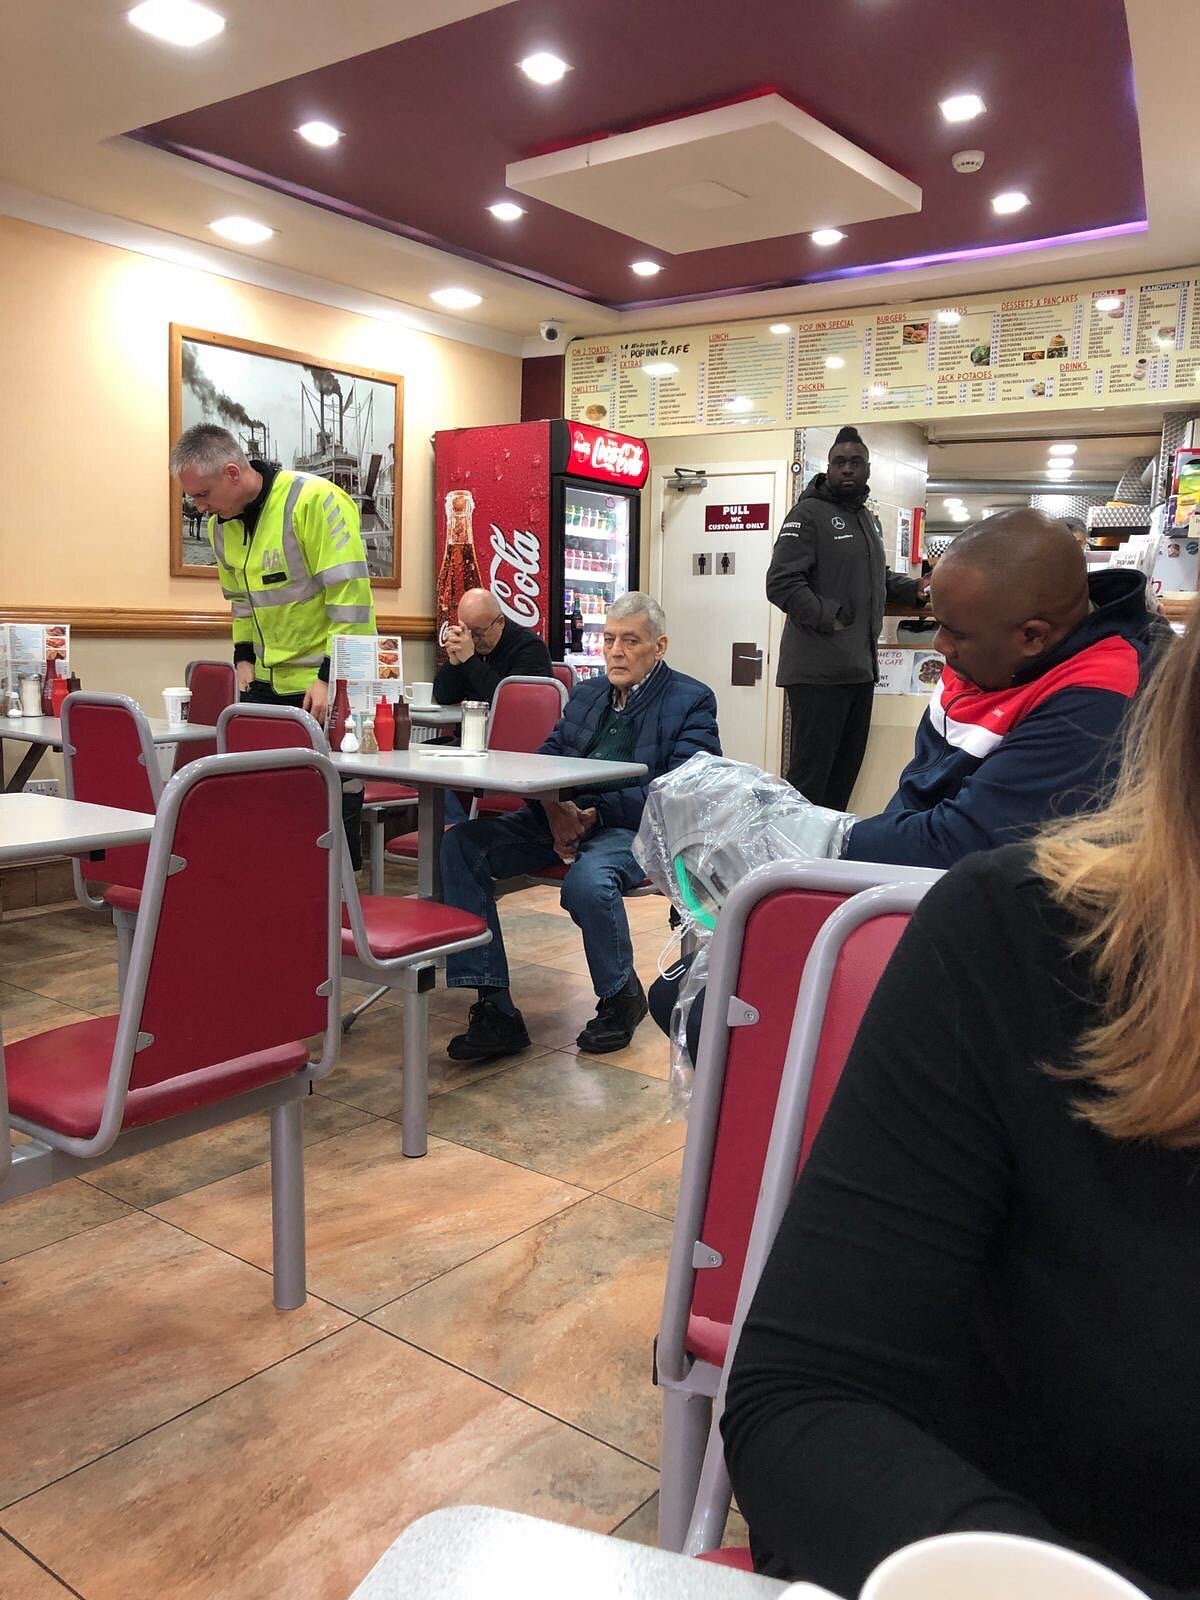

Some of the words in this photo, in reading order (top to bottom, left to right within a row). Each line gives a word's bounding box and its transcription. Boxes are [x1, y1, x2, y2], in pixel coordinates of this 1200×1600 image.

[1001, 299, 1034, 311] DESSERTS
[1043, 294, 1078, 305] PANCAKES
[876, 313, 907, 324] BURGERS
[815, 322, 827, 330] INN
[828, 320, 854, 329] SPECIAL
[708, 333, 729, 342] LUNCH
[630, 350, 645, 358] POP
[645, 348, 659, 357] INN
[660, 344, 690, 356] CAFE
[1059, 361, 1088, 371] DRINKS
[938, 374, 954, 383] JACK
[797, 383, 825, 393] CHICKEN
[722, 505, 750, 515] PULL
[262, 549, 281, 570] AA
[490, 523, 541, 627] Cola
